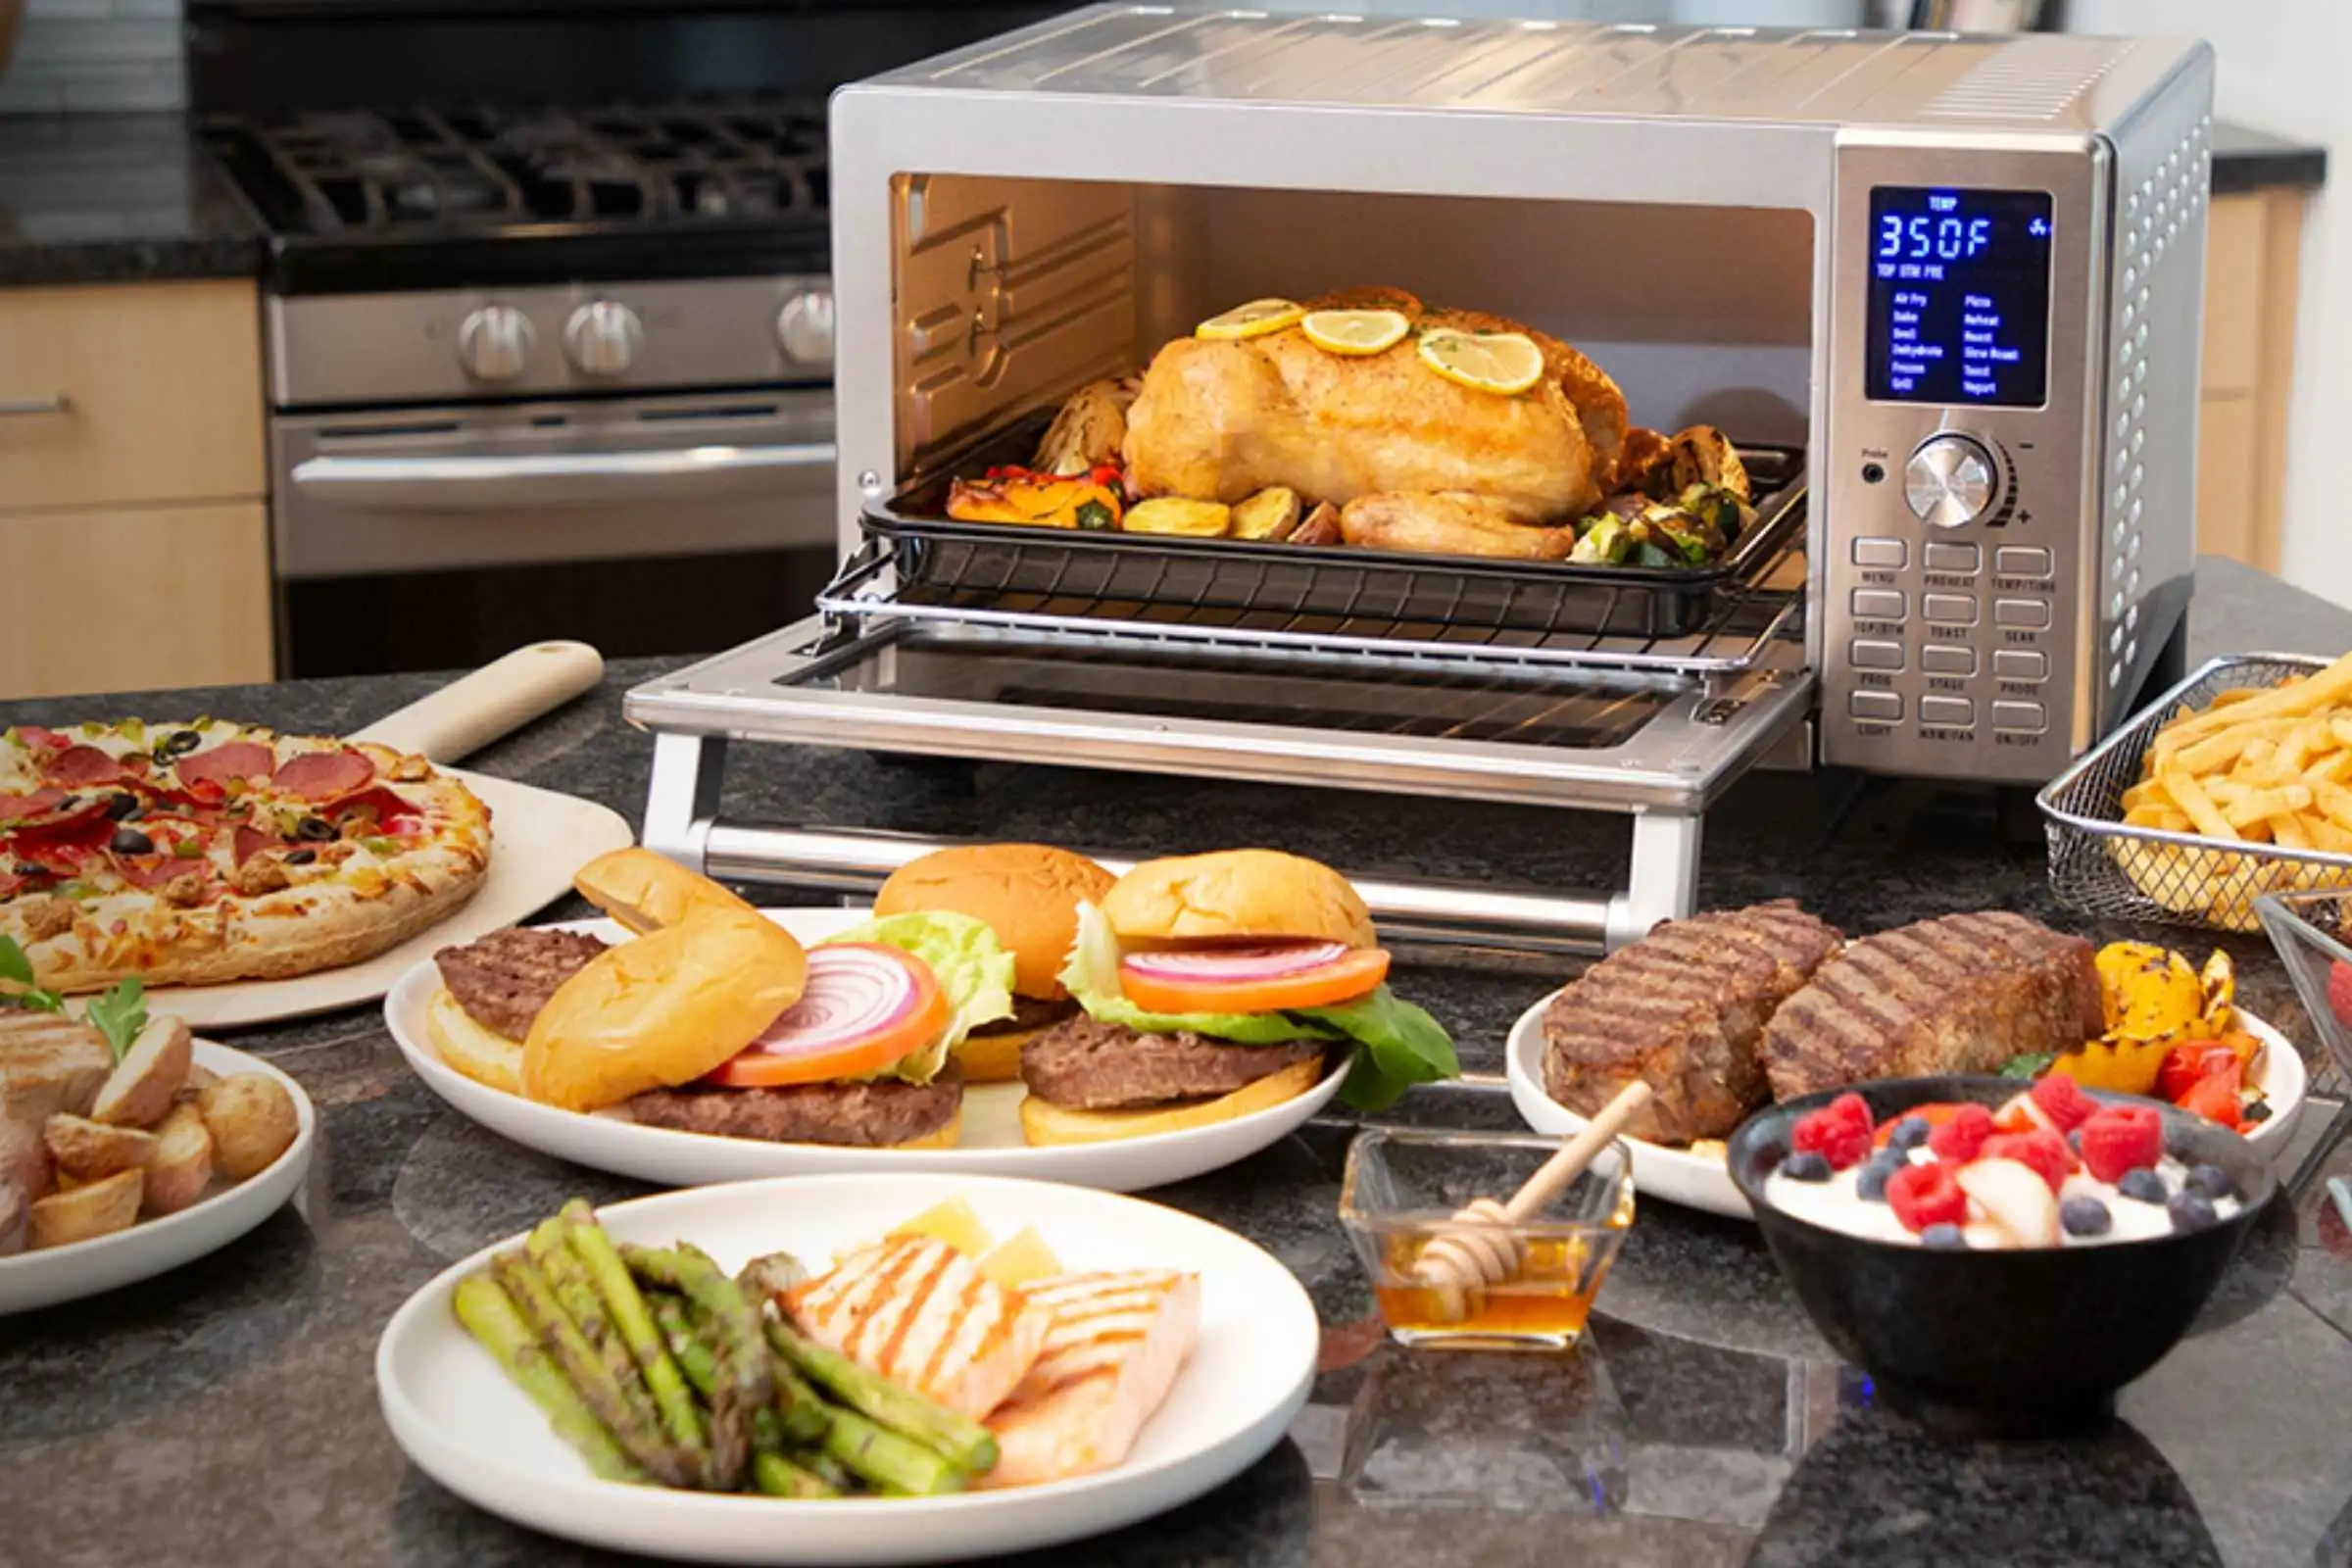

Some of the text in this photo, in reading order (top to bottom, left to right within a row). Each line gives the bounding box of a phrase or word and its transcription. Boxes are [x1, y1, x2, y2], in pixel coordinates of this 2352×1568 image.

[1929, 196, 1958, 212] TEMP
[1880, 216, 1990, 260] 350F
[1877, 263, 1896, 278] TOP
[1862, 571, 1895, 584] MENU
[1924, 573, 1977, 587] PREHEAT
[1930, 625, 1968, 639] TOAST
